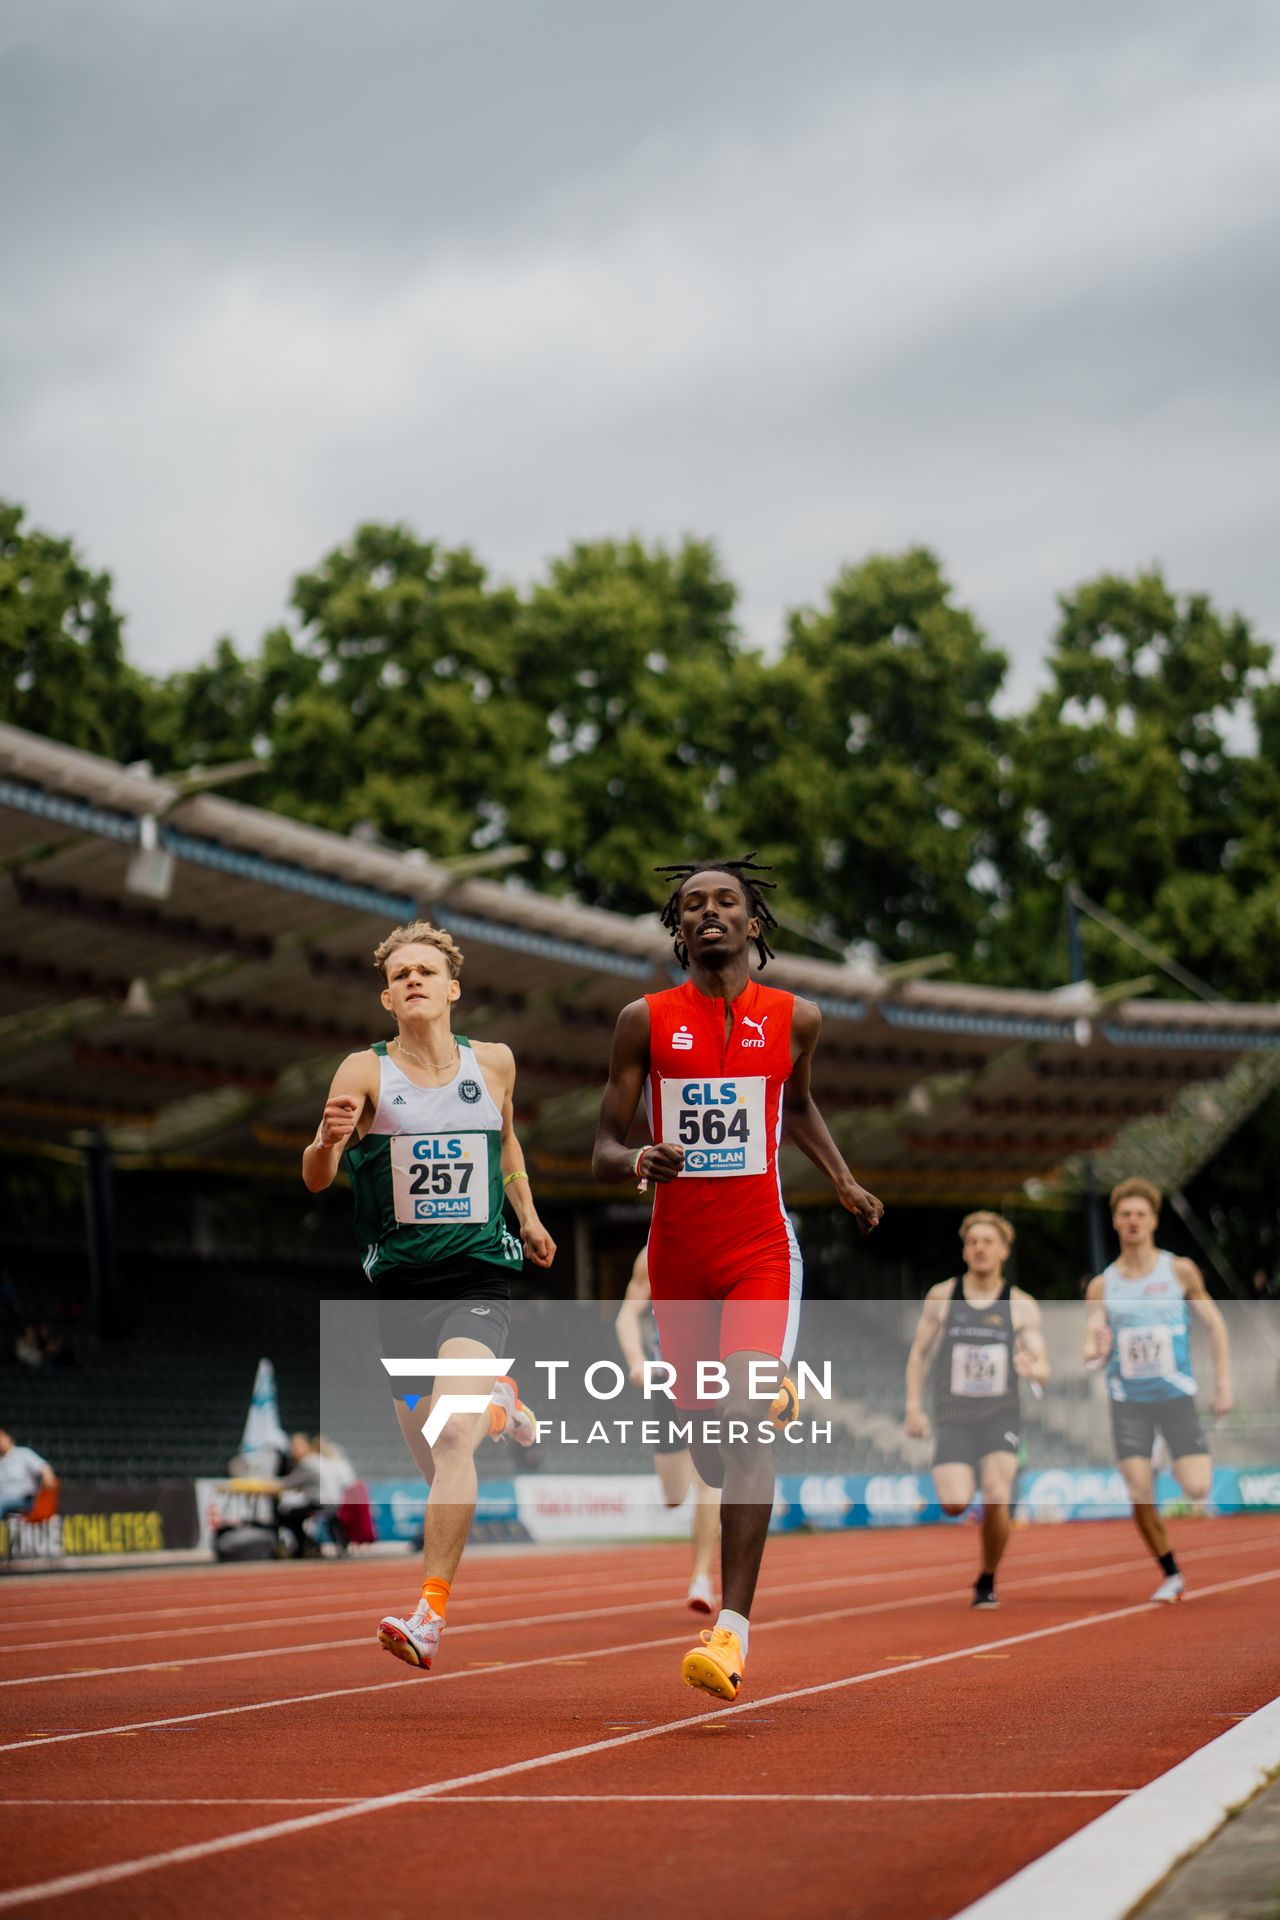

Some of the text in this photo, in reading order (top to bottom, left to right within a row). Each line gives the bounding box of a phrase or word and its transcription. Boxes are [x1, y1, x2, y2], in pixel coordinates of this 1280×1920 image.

[679, 1108, 750, 1145] 564
[709, 1151, 743, 1163] PLAN
[409, 1163, 474, 1195] 257
[437, 1201, 469, 1211] PLAN
